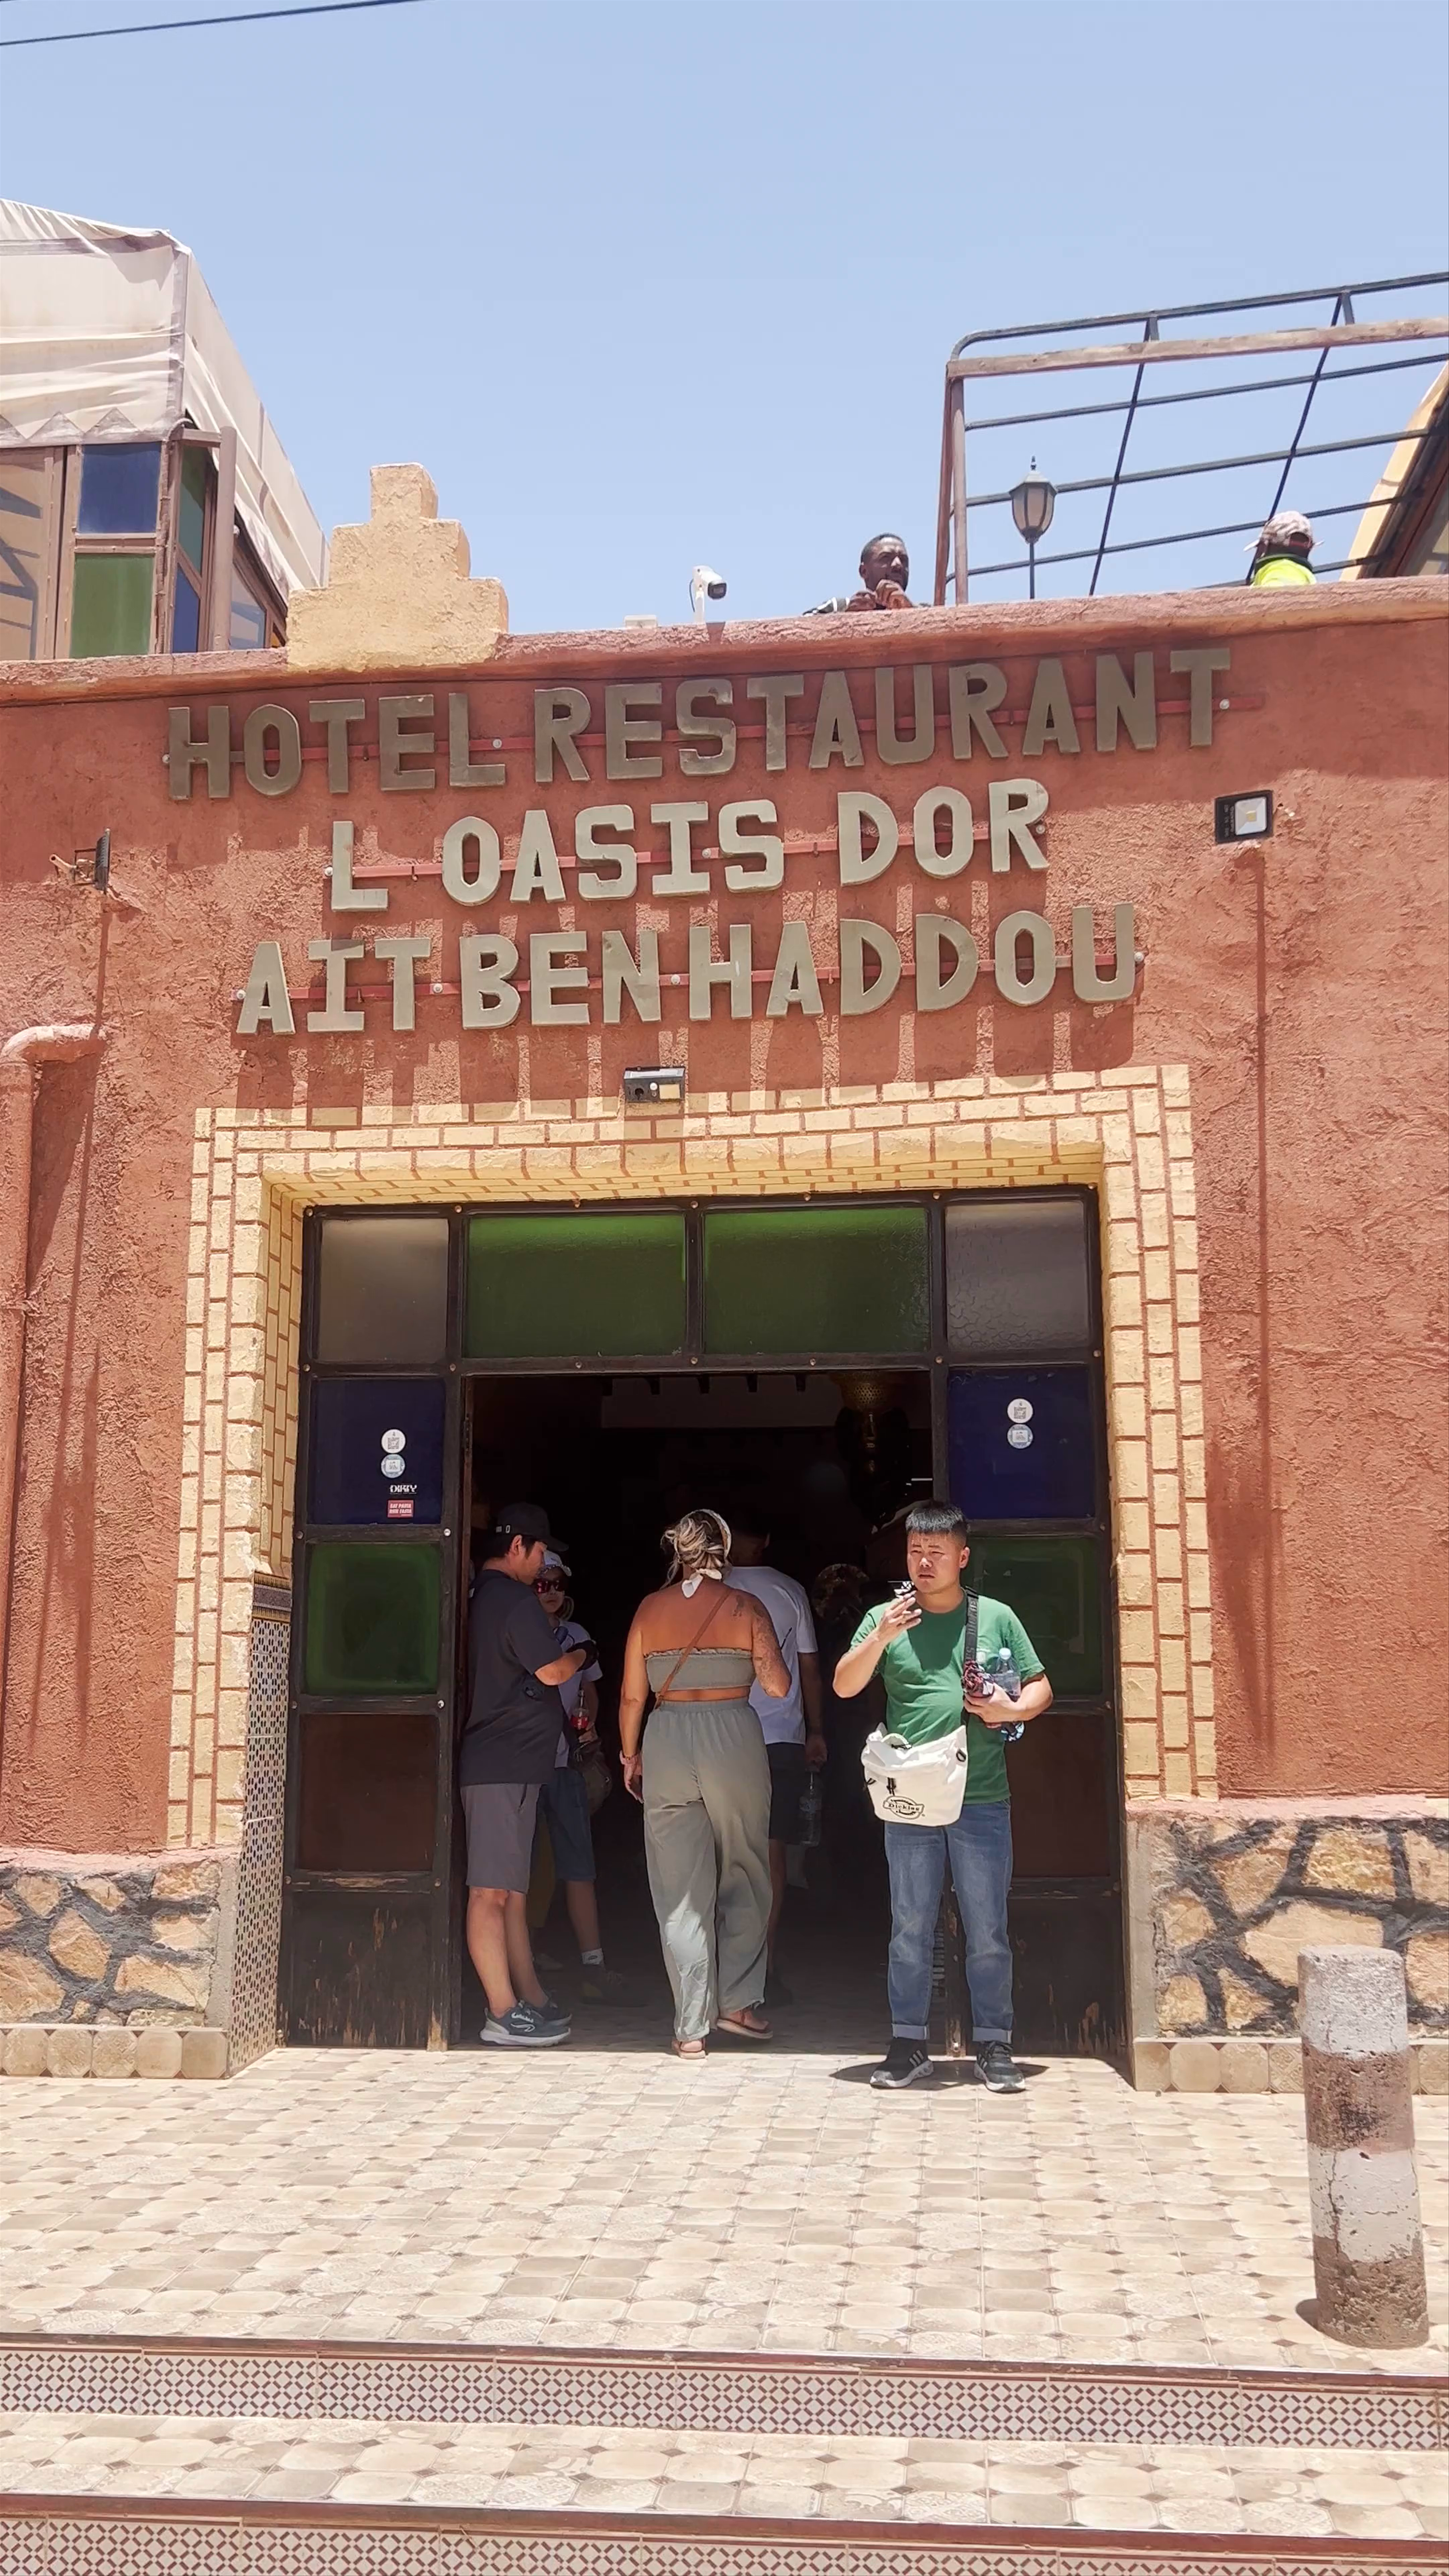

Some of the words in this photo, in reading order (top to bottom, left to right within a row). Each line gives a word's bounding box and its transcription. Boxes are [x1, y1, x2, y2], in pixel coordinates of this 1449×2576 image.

[168, 692, 506, 800] HOTEL
[534, 648, 1231, 782] RESTAURANT
[331, 821, 388, 912] L
[441, 800, 784, 905] OASIS
[838, 778, 1049, 886] DOR
[236, 937, 432, 1035] AIT
